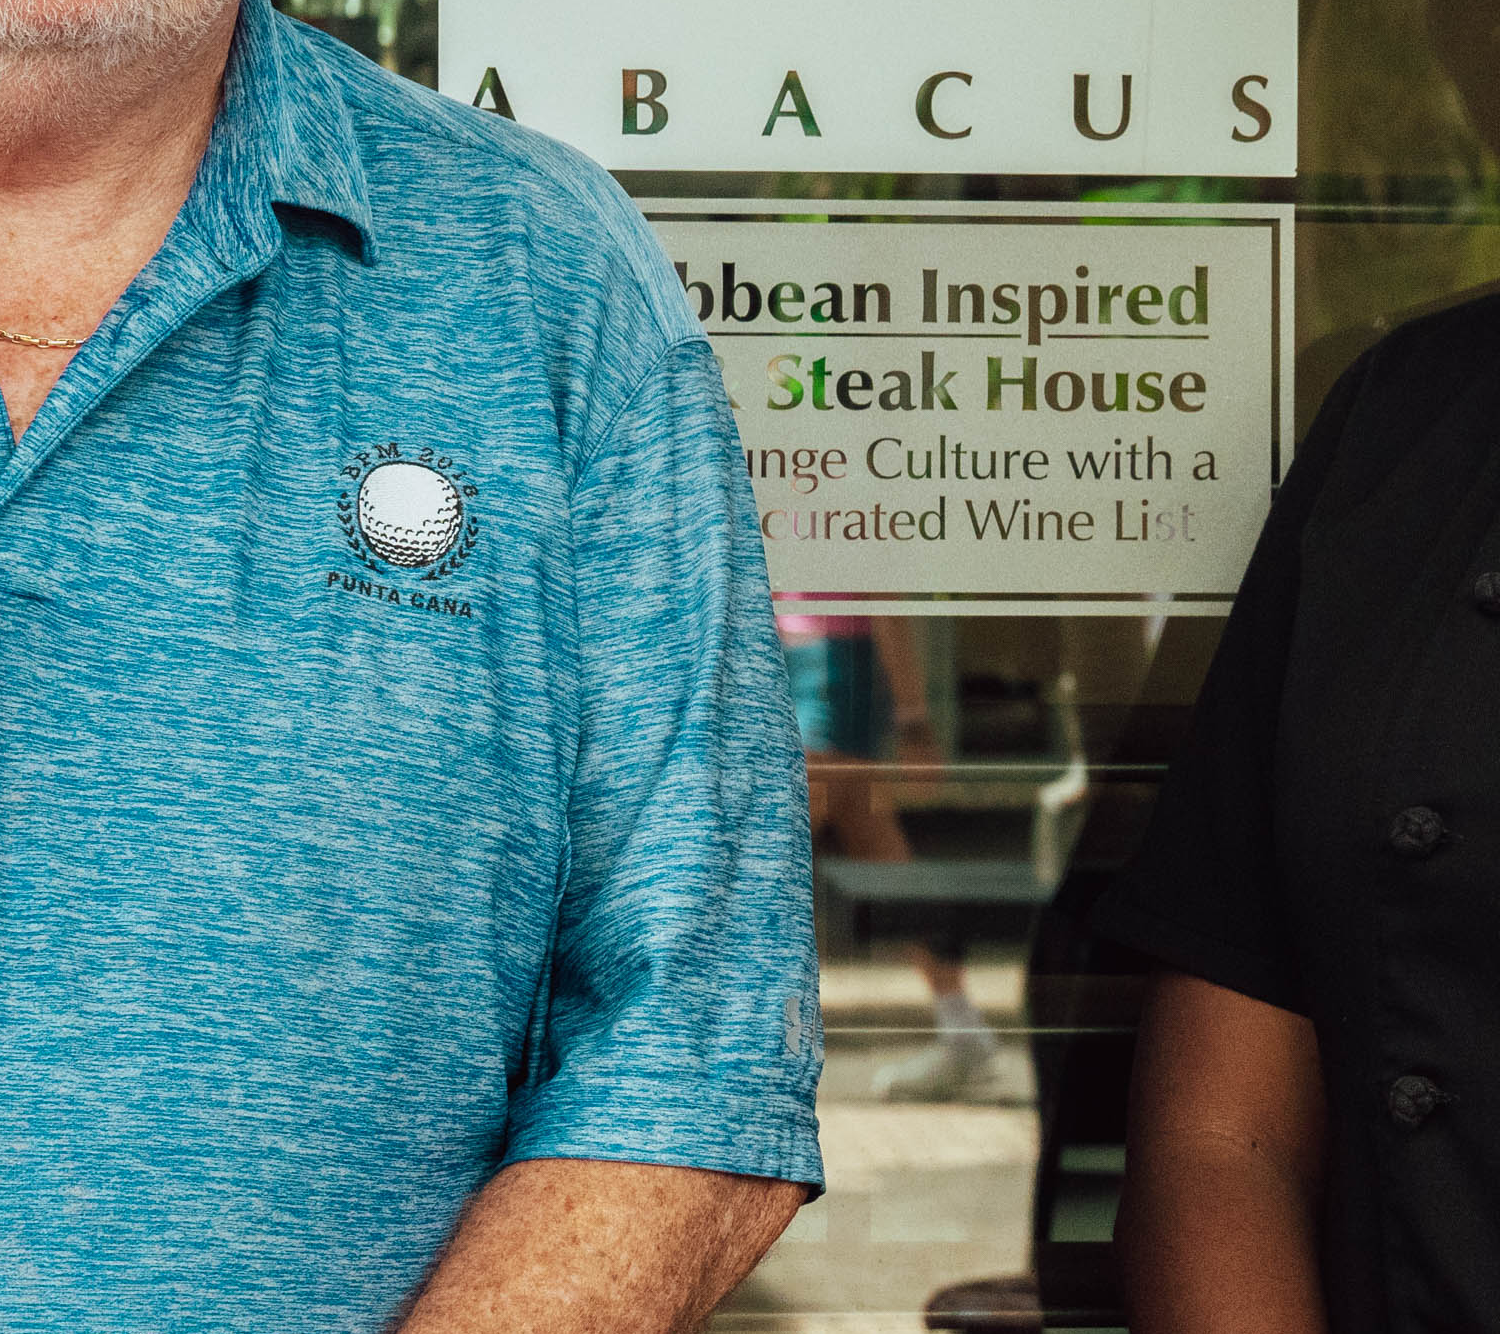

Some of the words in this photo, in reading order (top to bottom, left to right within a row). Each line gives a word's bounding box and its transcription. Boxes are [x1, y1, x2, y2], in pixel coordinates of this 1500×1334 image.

[674, 261, 891, 324] bbean
[921, 263, 1210, 346] Inspired
[766, 353, 958, 414] Steak
[986, 359, 1208, 415] House
[747, 447, 848, 495] nge
[866, 435, 1050, 483] Culture
[1065, 434, 1173, 483] with
[1191, 448, 1219, 483] a
[761, 491, 946, 543] curated
[964, 494, 1096, 543] Wine
[1115, 496, 1195, 545] List
[326, 570, 401, 606] PUNTA
[410, 591, 473, 620] CANA
